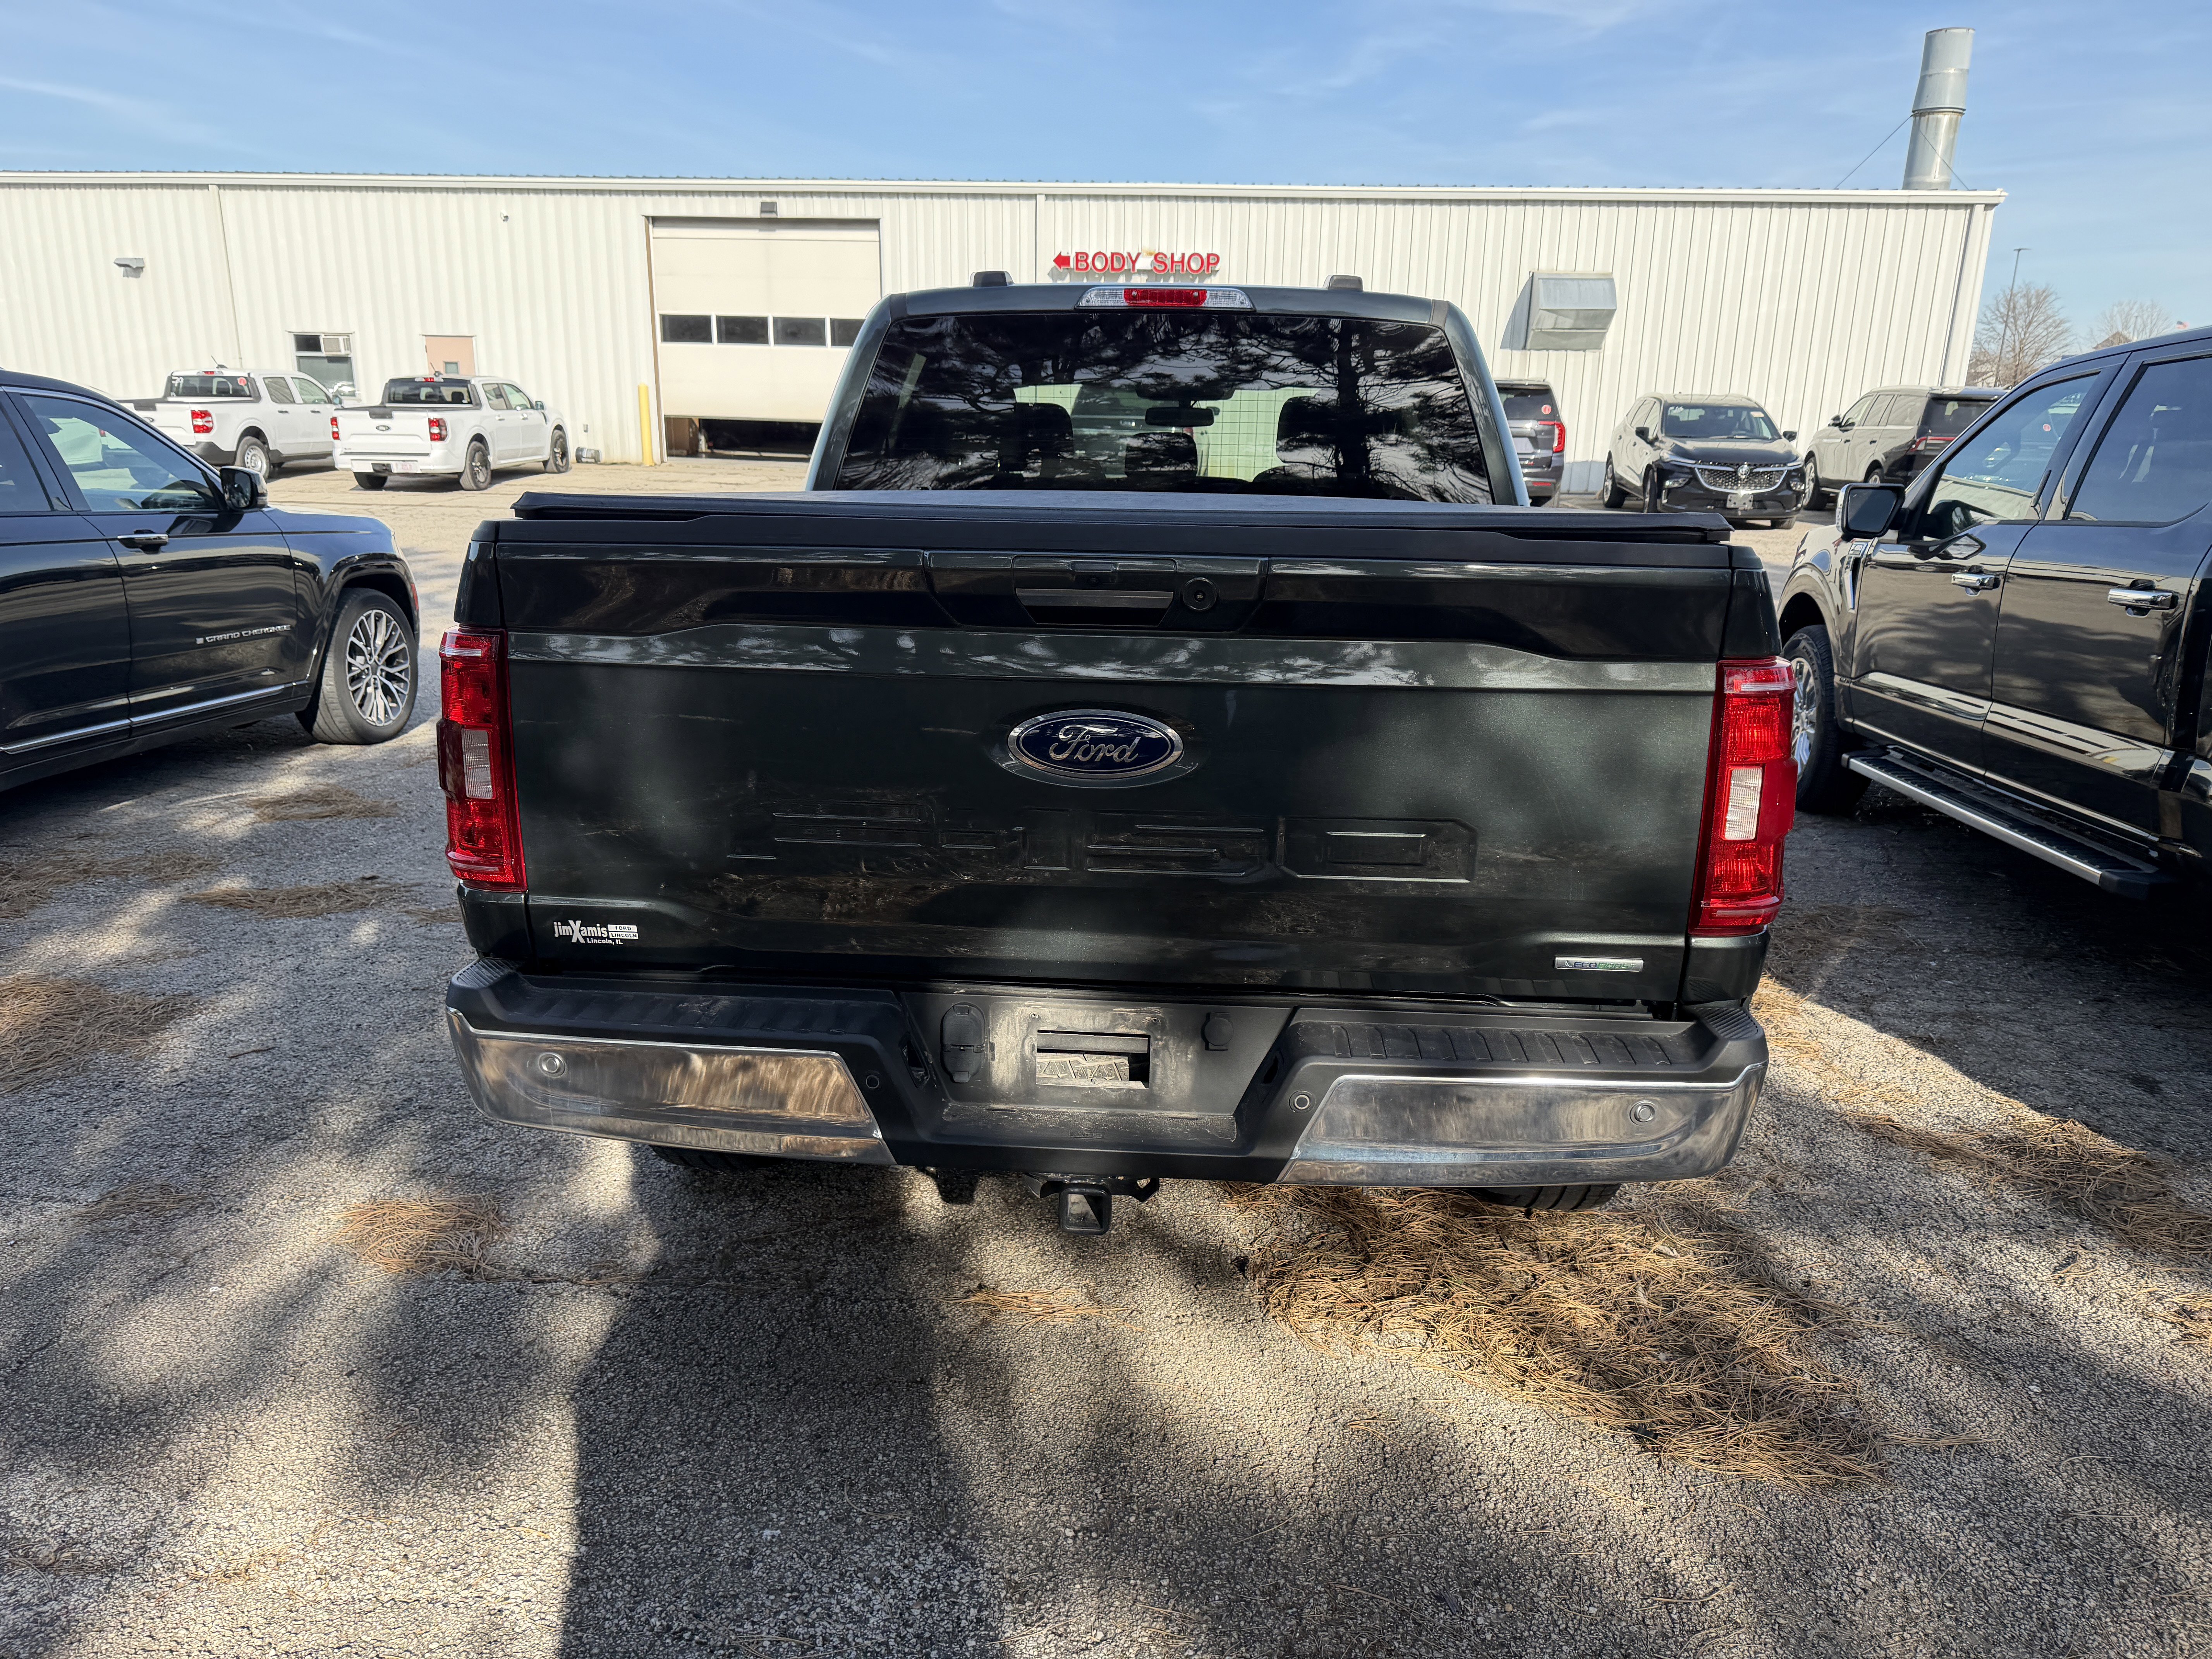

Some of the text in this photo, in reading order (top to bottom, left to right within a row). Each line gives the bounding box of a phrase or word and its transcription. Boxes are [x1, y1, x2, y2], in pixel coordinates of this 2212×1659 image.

[1075, 251, 1220, 274] BODY SHOP
[206, 625, 290, 642] GRAND CHEROKEE
[1049, 725, 1140, 763] Ford
